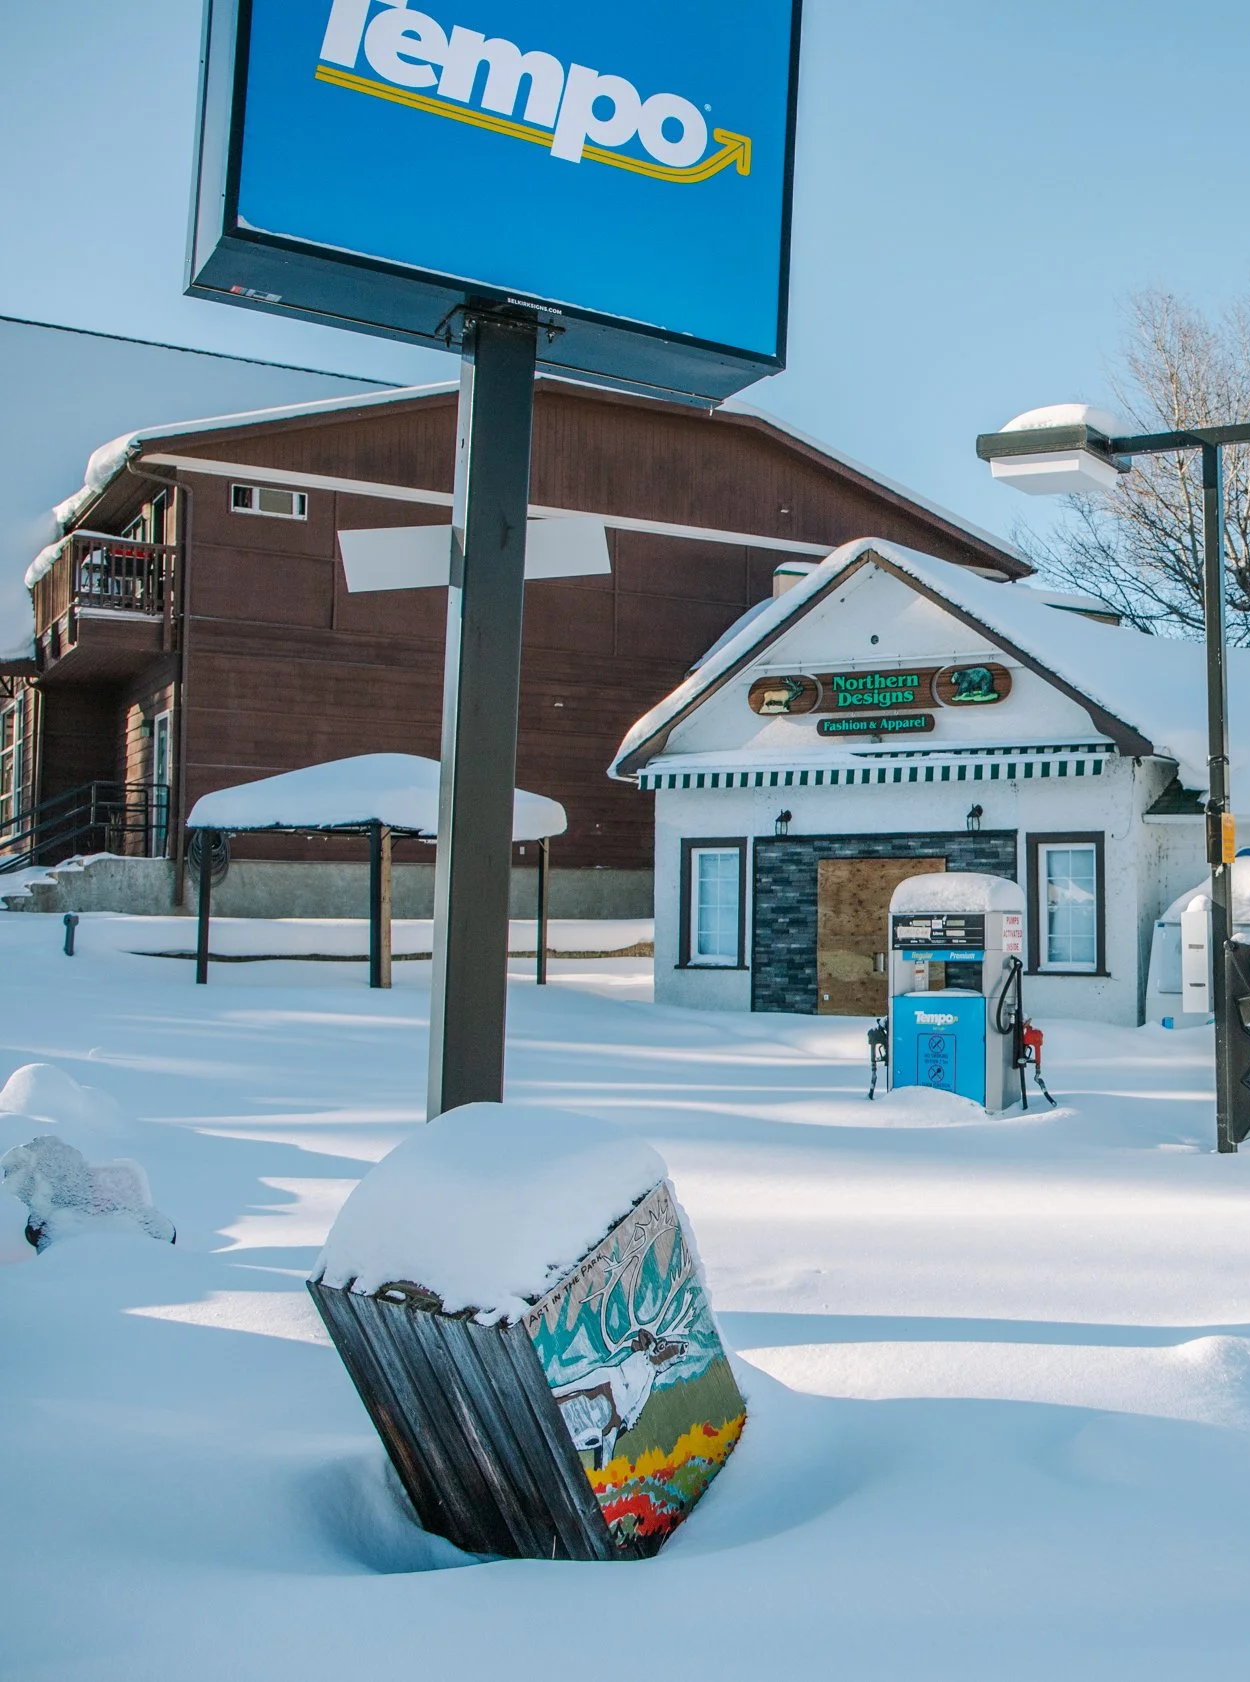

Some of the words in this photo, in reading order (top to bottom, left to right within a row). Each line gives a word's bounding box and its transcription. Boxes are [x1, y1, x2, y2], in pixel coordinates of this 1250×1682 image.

[319, 0, 708, 164] Tempo
[507, 297, 563, 315] SELKIRKSIGNS.COM
[832, 674, 919, 691] Northern
[837, 689, 915, 707] Designs
[823, 720, 868, 732] Fashion
[869, 721, 877, 729] &
[880, 716, 926, 731] Apparel
[1006, 916, 1019, 925] PUMPS
[949, 951, 976, 960] Premium
[914, 1010, 954, 1026] Tempo
[528, 1303, 549, 1328] ART
[551, 1293, 561, 1304] IN
[563, 1275, 580, 1293] THE
[580, 1253, 604, 1277] PARK
